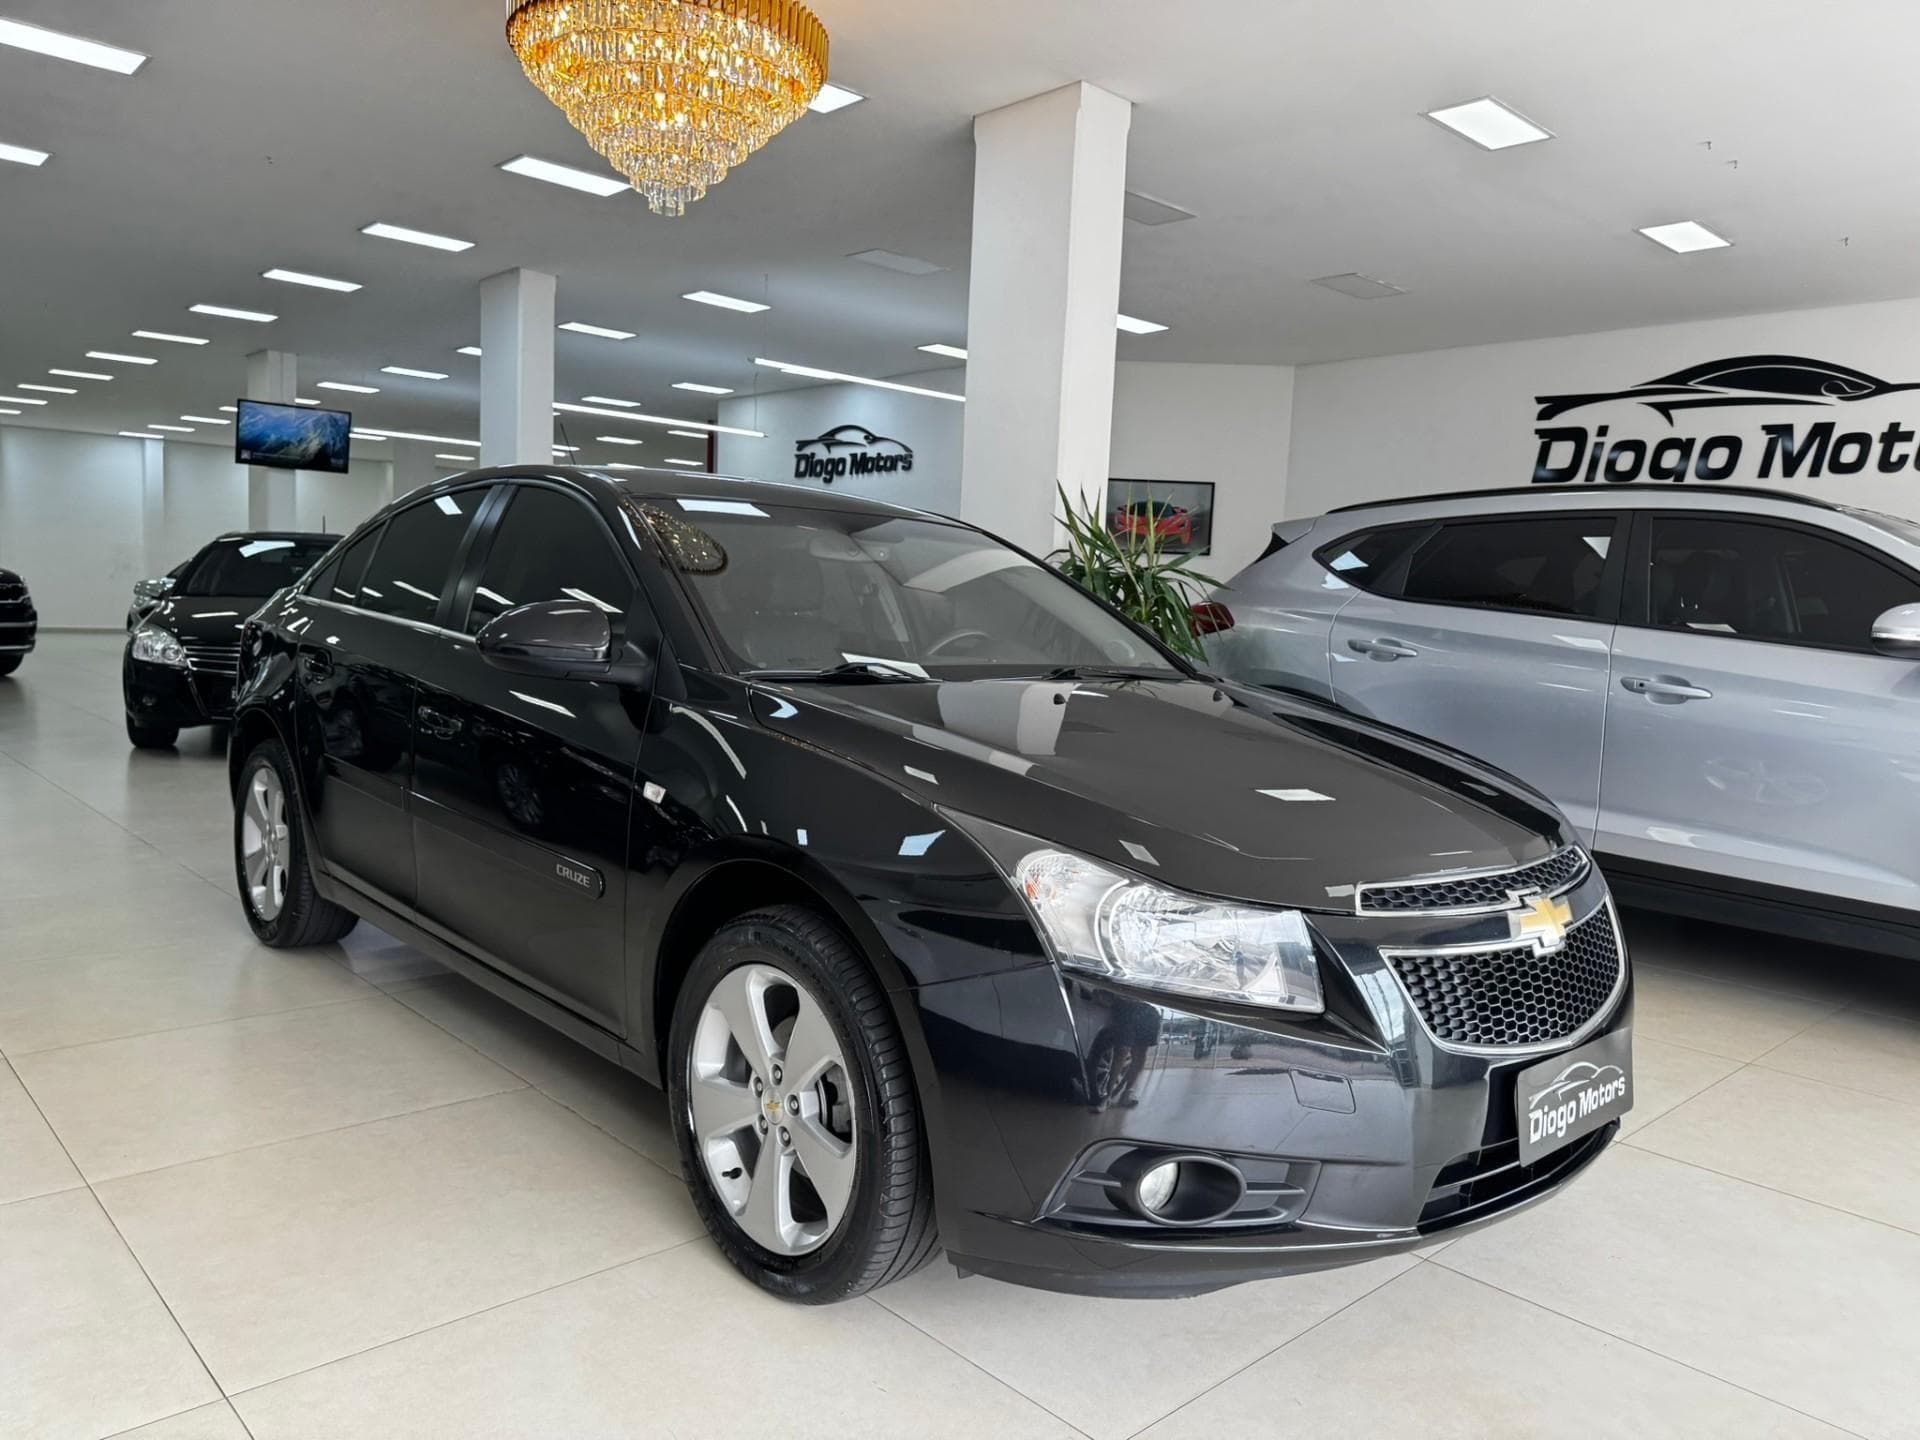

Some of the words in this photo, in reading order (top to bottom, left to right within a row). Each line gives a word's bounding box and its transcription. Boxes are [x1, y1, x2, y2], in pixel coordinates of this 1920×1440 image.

[794, 452, 847, 484] Diogo
[849, 452, 914, 476] Motors
[1757, 421, 1920, 479] Mot
[556, 863, 591, 888] CRUZE
[1528, 1100, 1577, 1145] Diogo
[1578, 1076, 1626, 1119] Motors
